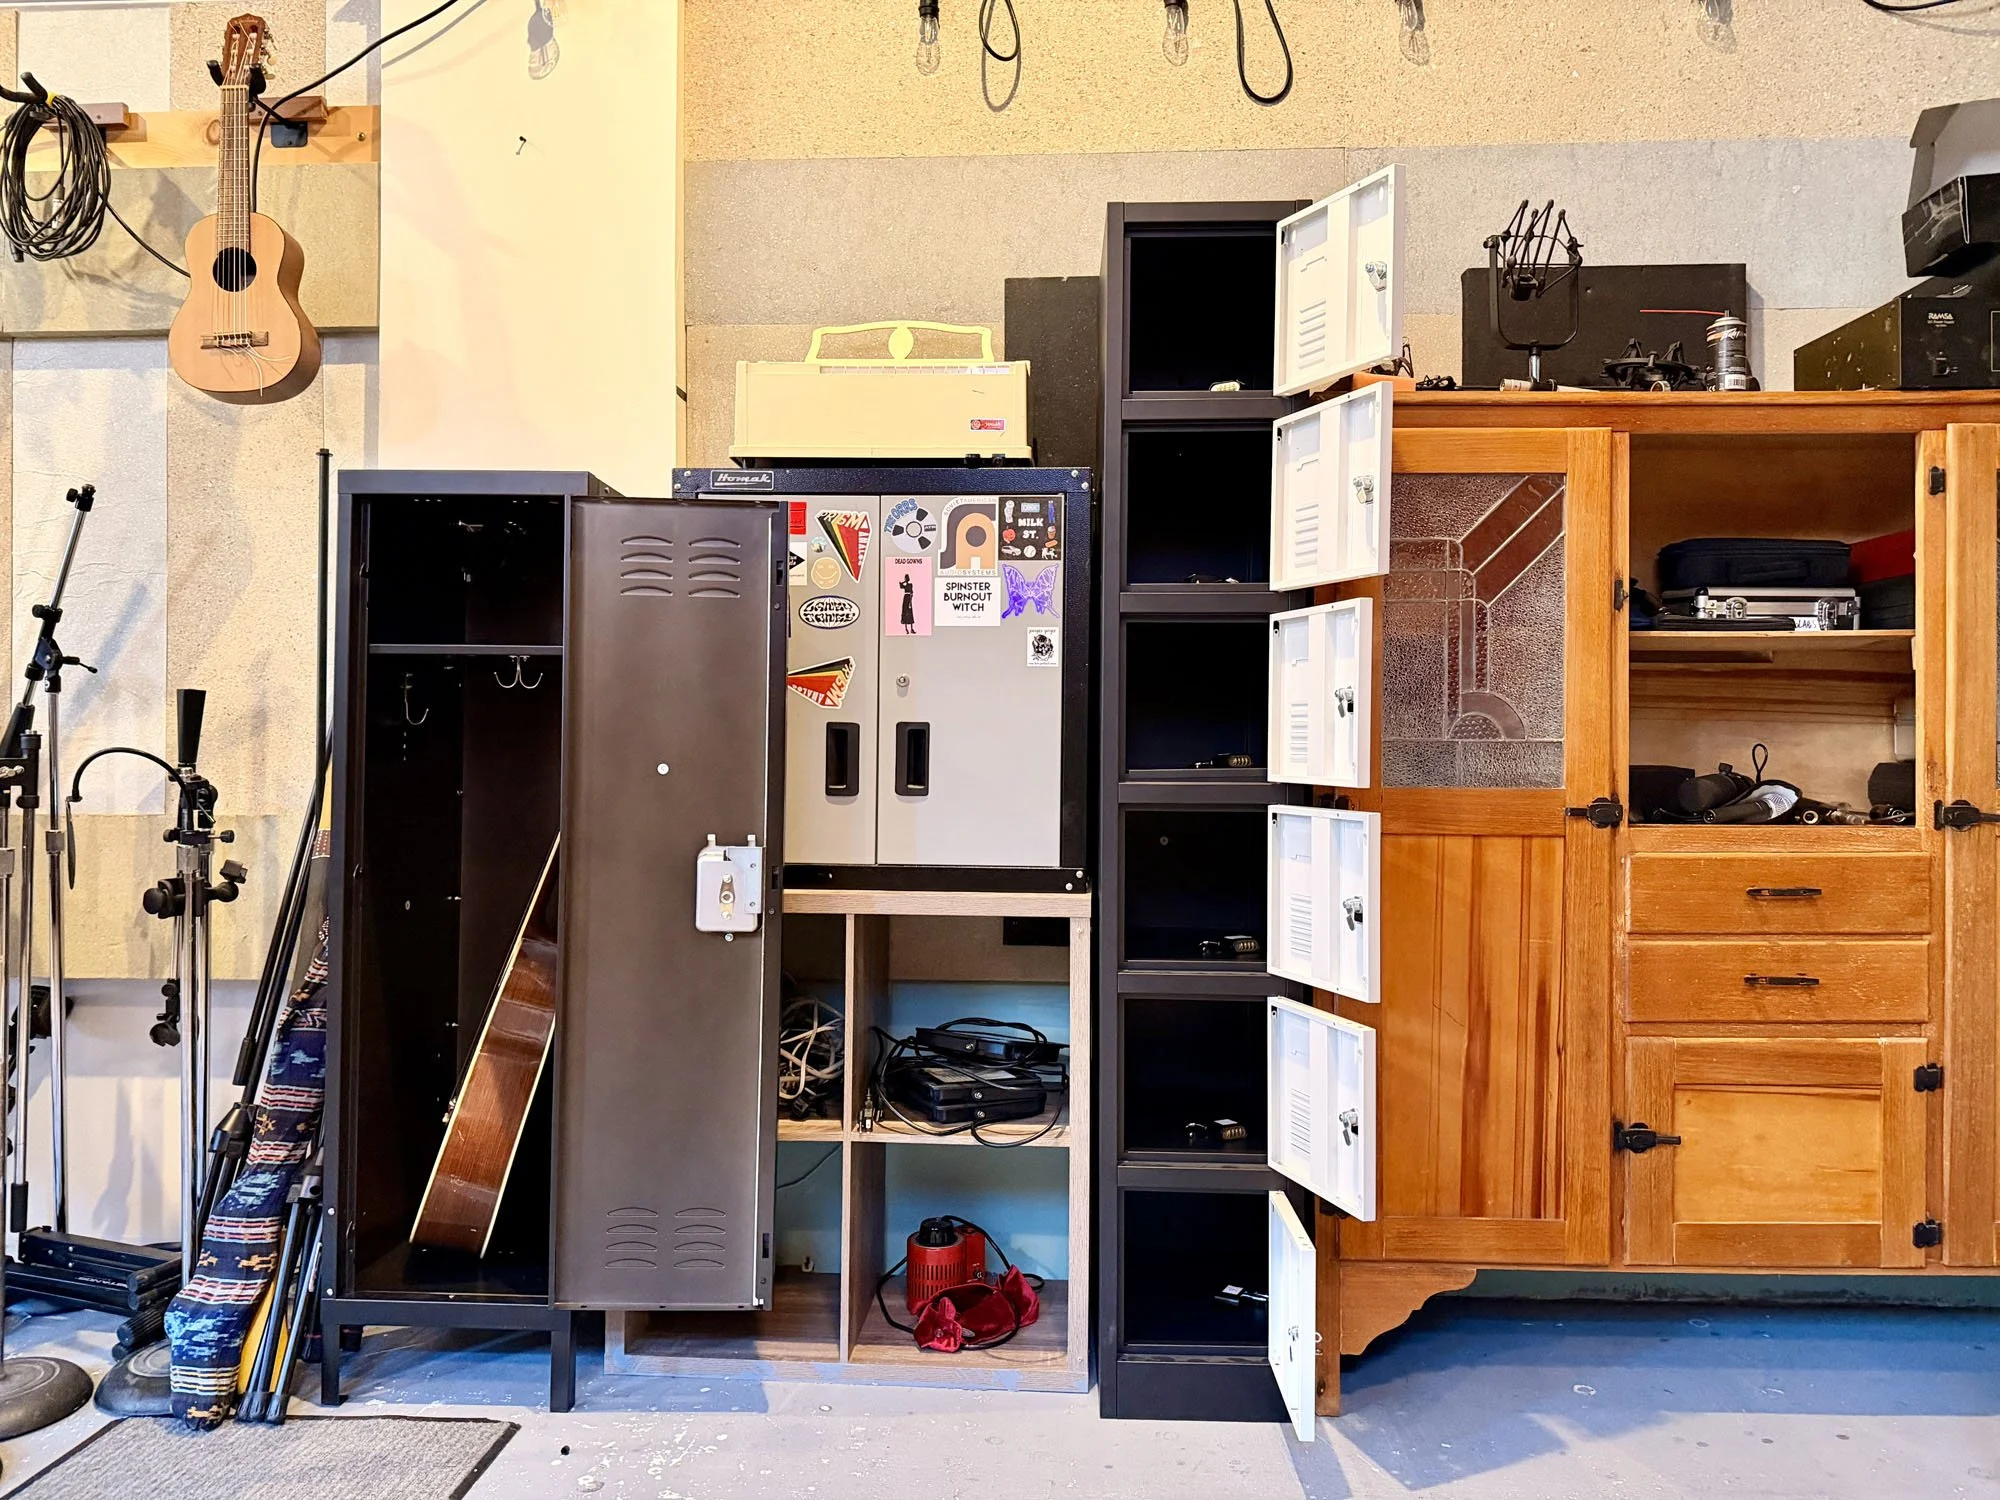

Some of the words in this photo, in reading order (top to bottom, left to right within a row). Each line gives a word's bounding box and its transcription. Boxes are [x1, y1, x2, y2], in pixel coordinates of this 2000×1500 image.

[1928, 312, 1954, 320] RAMSA
[717, 473, 771, 483] Homak
[816, 511, 866, 531] PRISM
[1018, 518, 1044, 527] MILK
[1022, 530, 1039, 539] ST.
[945, 582, 991, 591] SPINSTER
[943, 592, 993, 602] BURNOUT
[953, 603, 985, 612] WITCH
